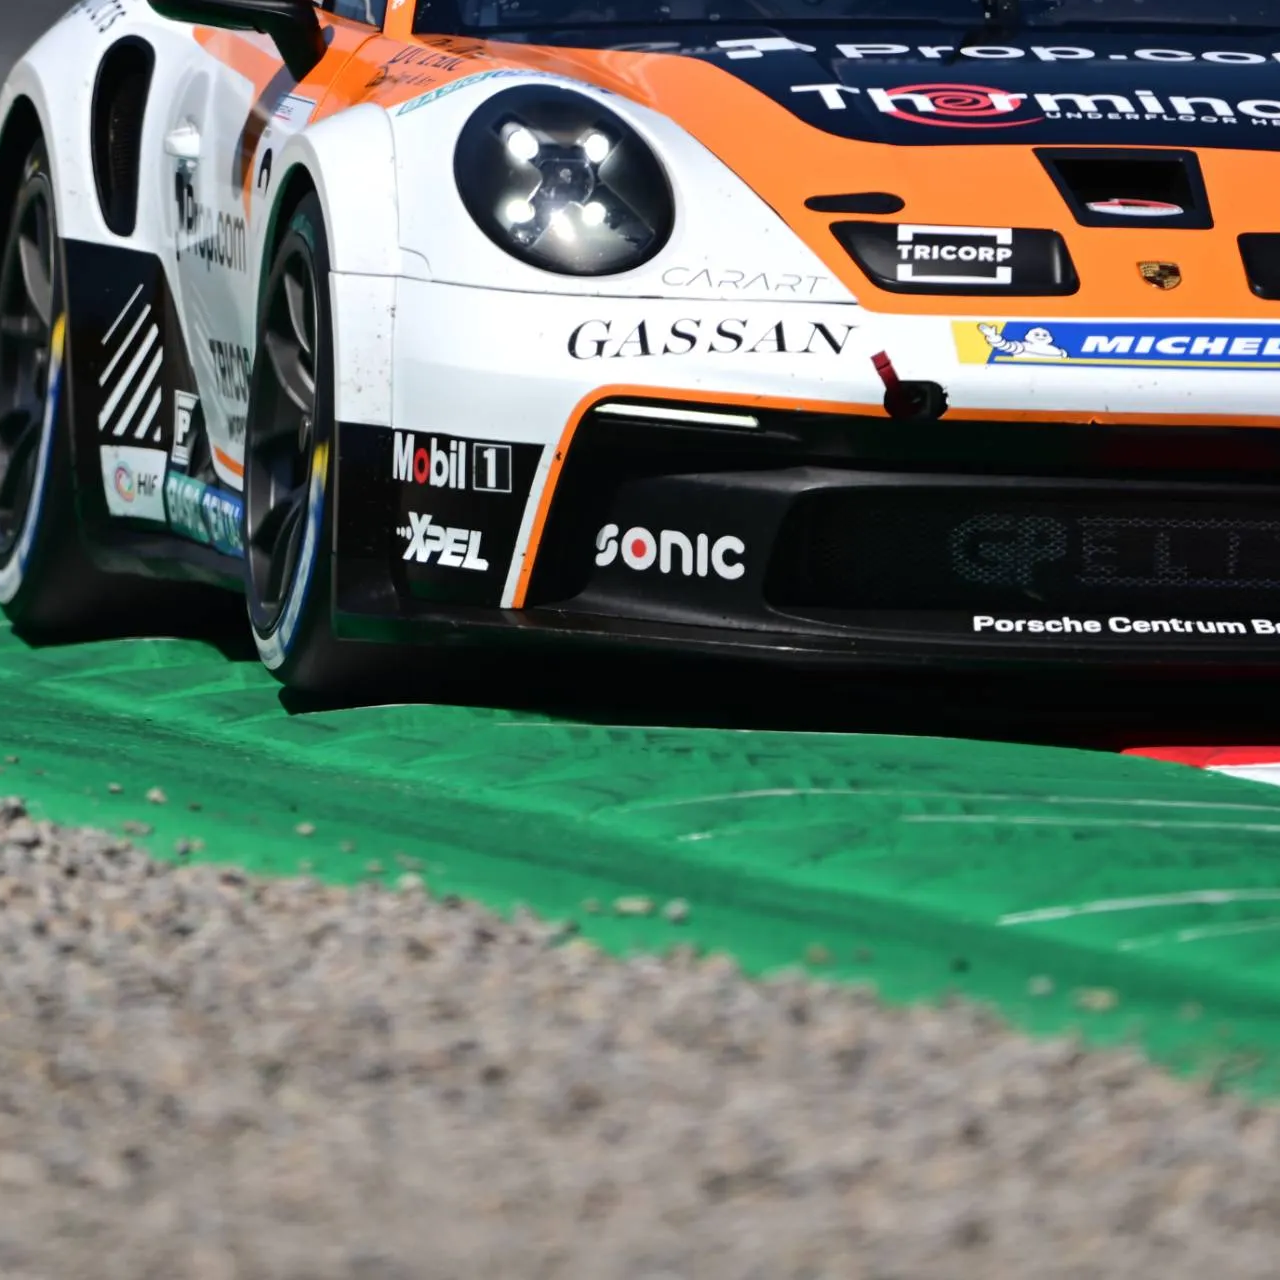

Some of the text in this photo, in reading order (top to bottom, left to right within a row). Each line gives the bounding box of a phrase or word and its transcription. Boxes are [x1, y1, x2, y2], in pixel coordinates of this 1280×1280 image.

[1044, 111, 1238, 124] UNDERFLOOR
[897, 243, 1013, 263] TRICORP
[661, 266, 827, 295] CARART
[568, 320, 857, 359] GASSAN
[393, 431, 497, 490] Mobil 1
[402, 511, 489, 571] XPEL
[973, 615, 1102, 633] Porsche
[1109, 617, 1246, 634] Centrum
